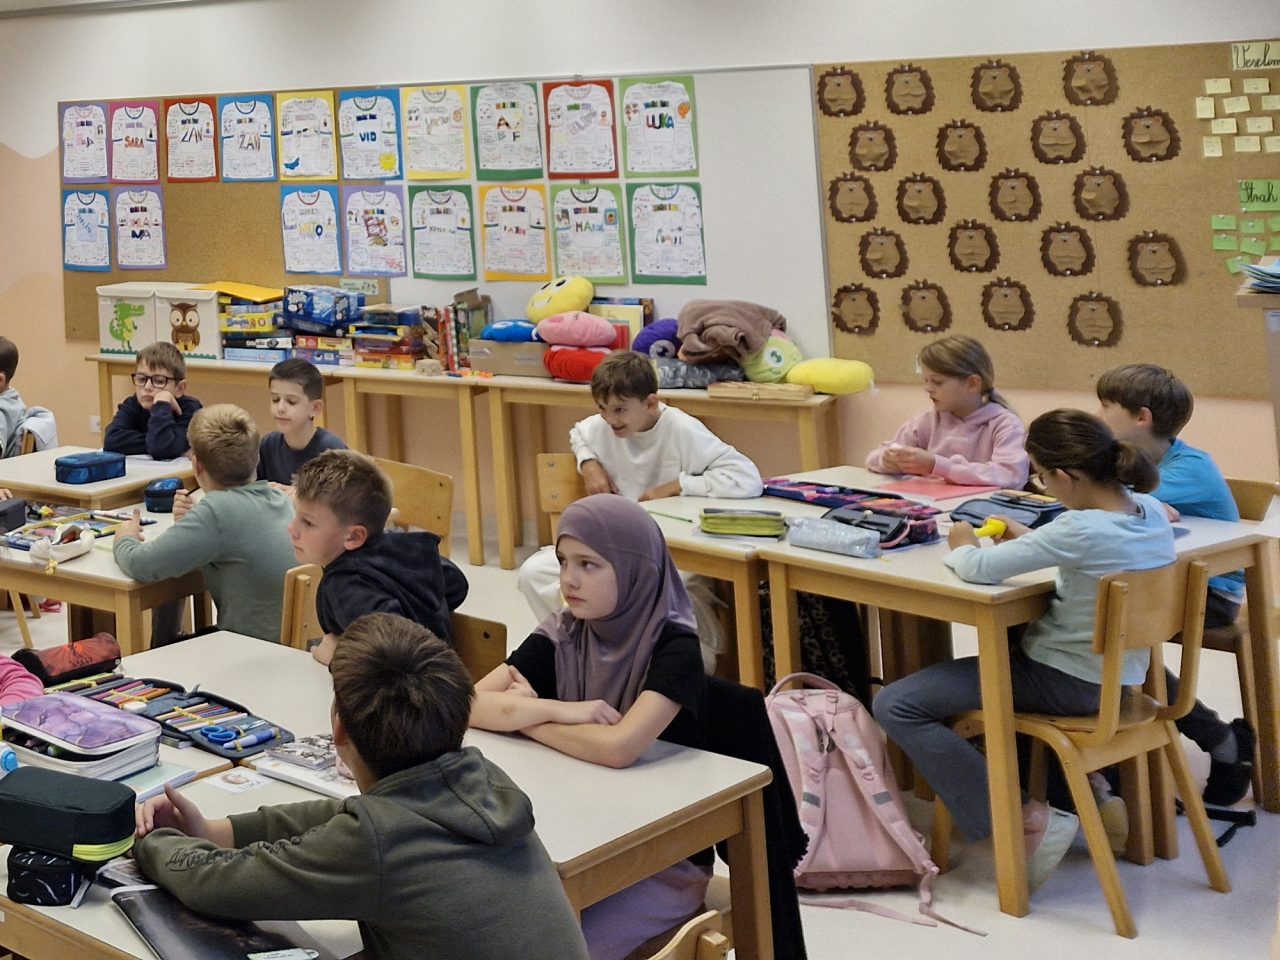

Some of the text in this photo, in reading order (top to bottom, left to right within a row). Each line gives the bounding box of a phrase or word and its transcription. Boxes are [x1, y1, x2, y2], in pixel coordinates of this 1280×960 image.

[124, 136, 145, 149] SARA
[359, 131, 377, 142] VID
[1240, 181, 1278, 203] Strah
